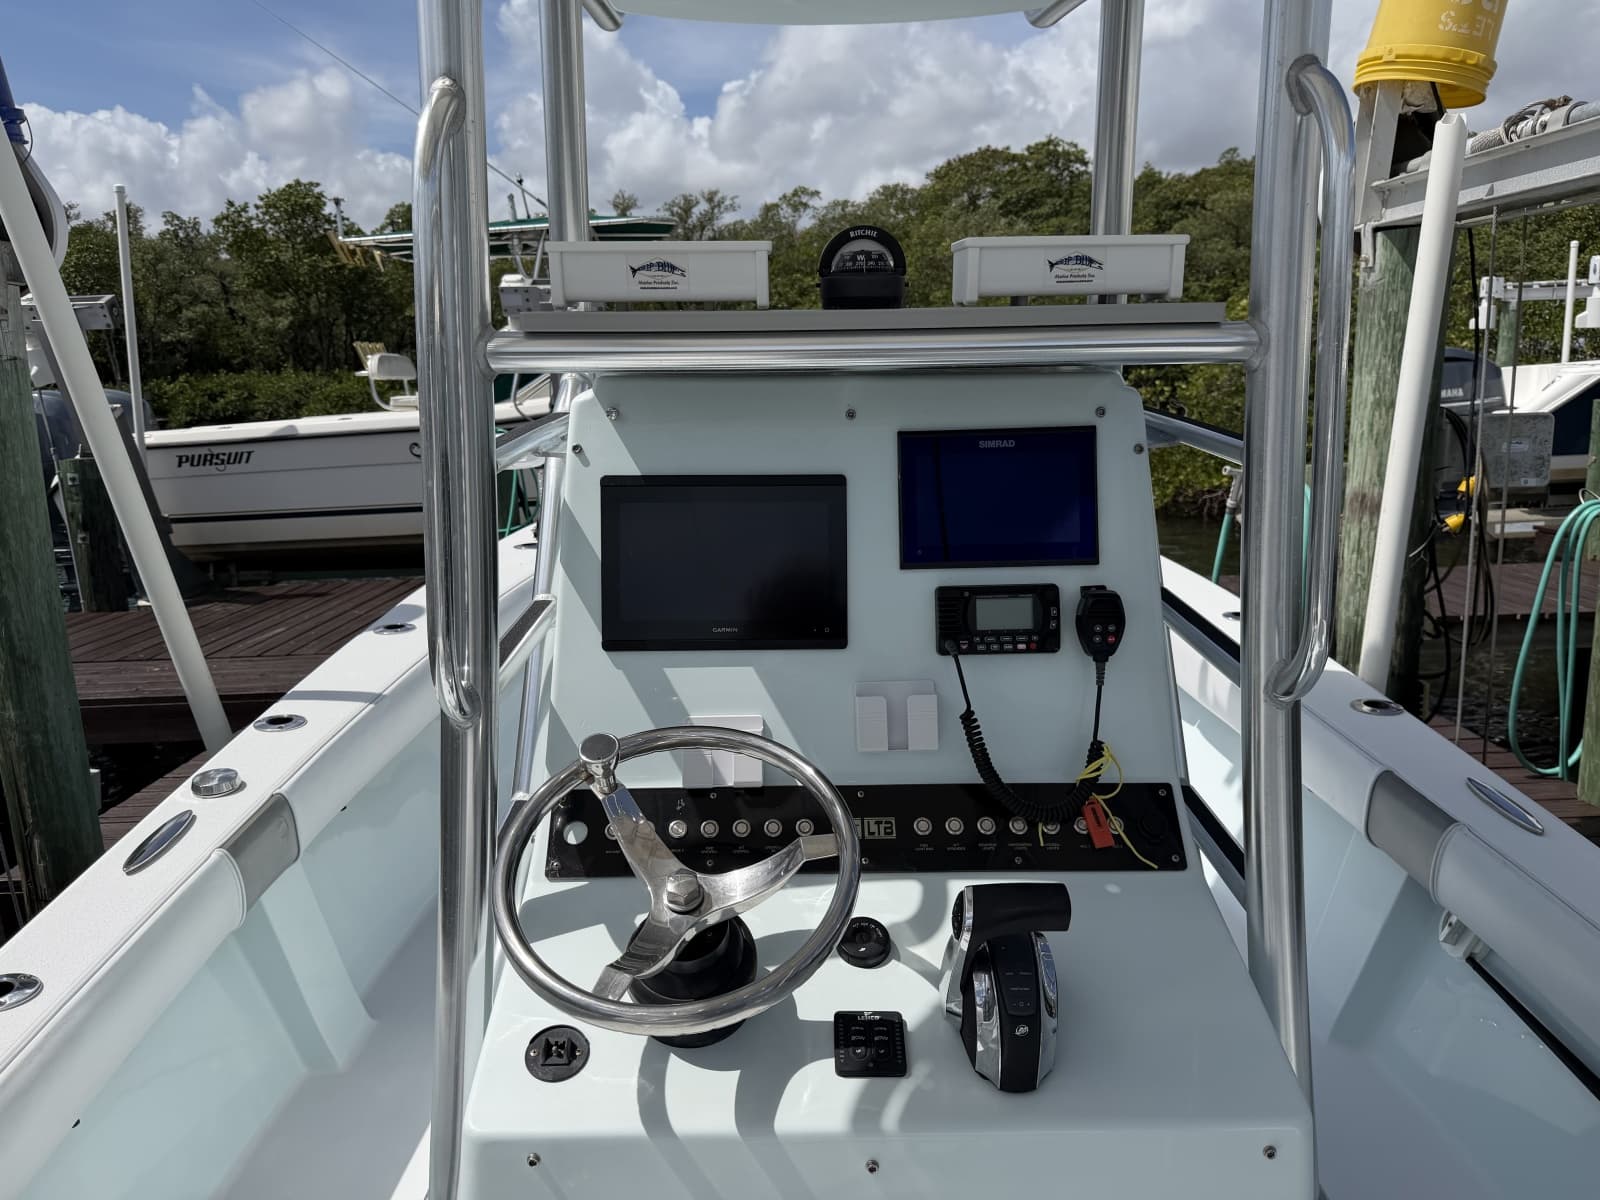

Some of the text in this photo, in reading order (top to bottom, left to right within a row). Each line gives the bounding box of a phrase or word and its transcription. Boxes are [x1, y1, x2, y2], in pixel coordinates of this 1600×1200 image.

[849, 229, 878, 238] RITCHIE
[978, 439, 1016, 449] SIMRAD
[176, 450, 255, 471] PURSUIT
